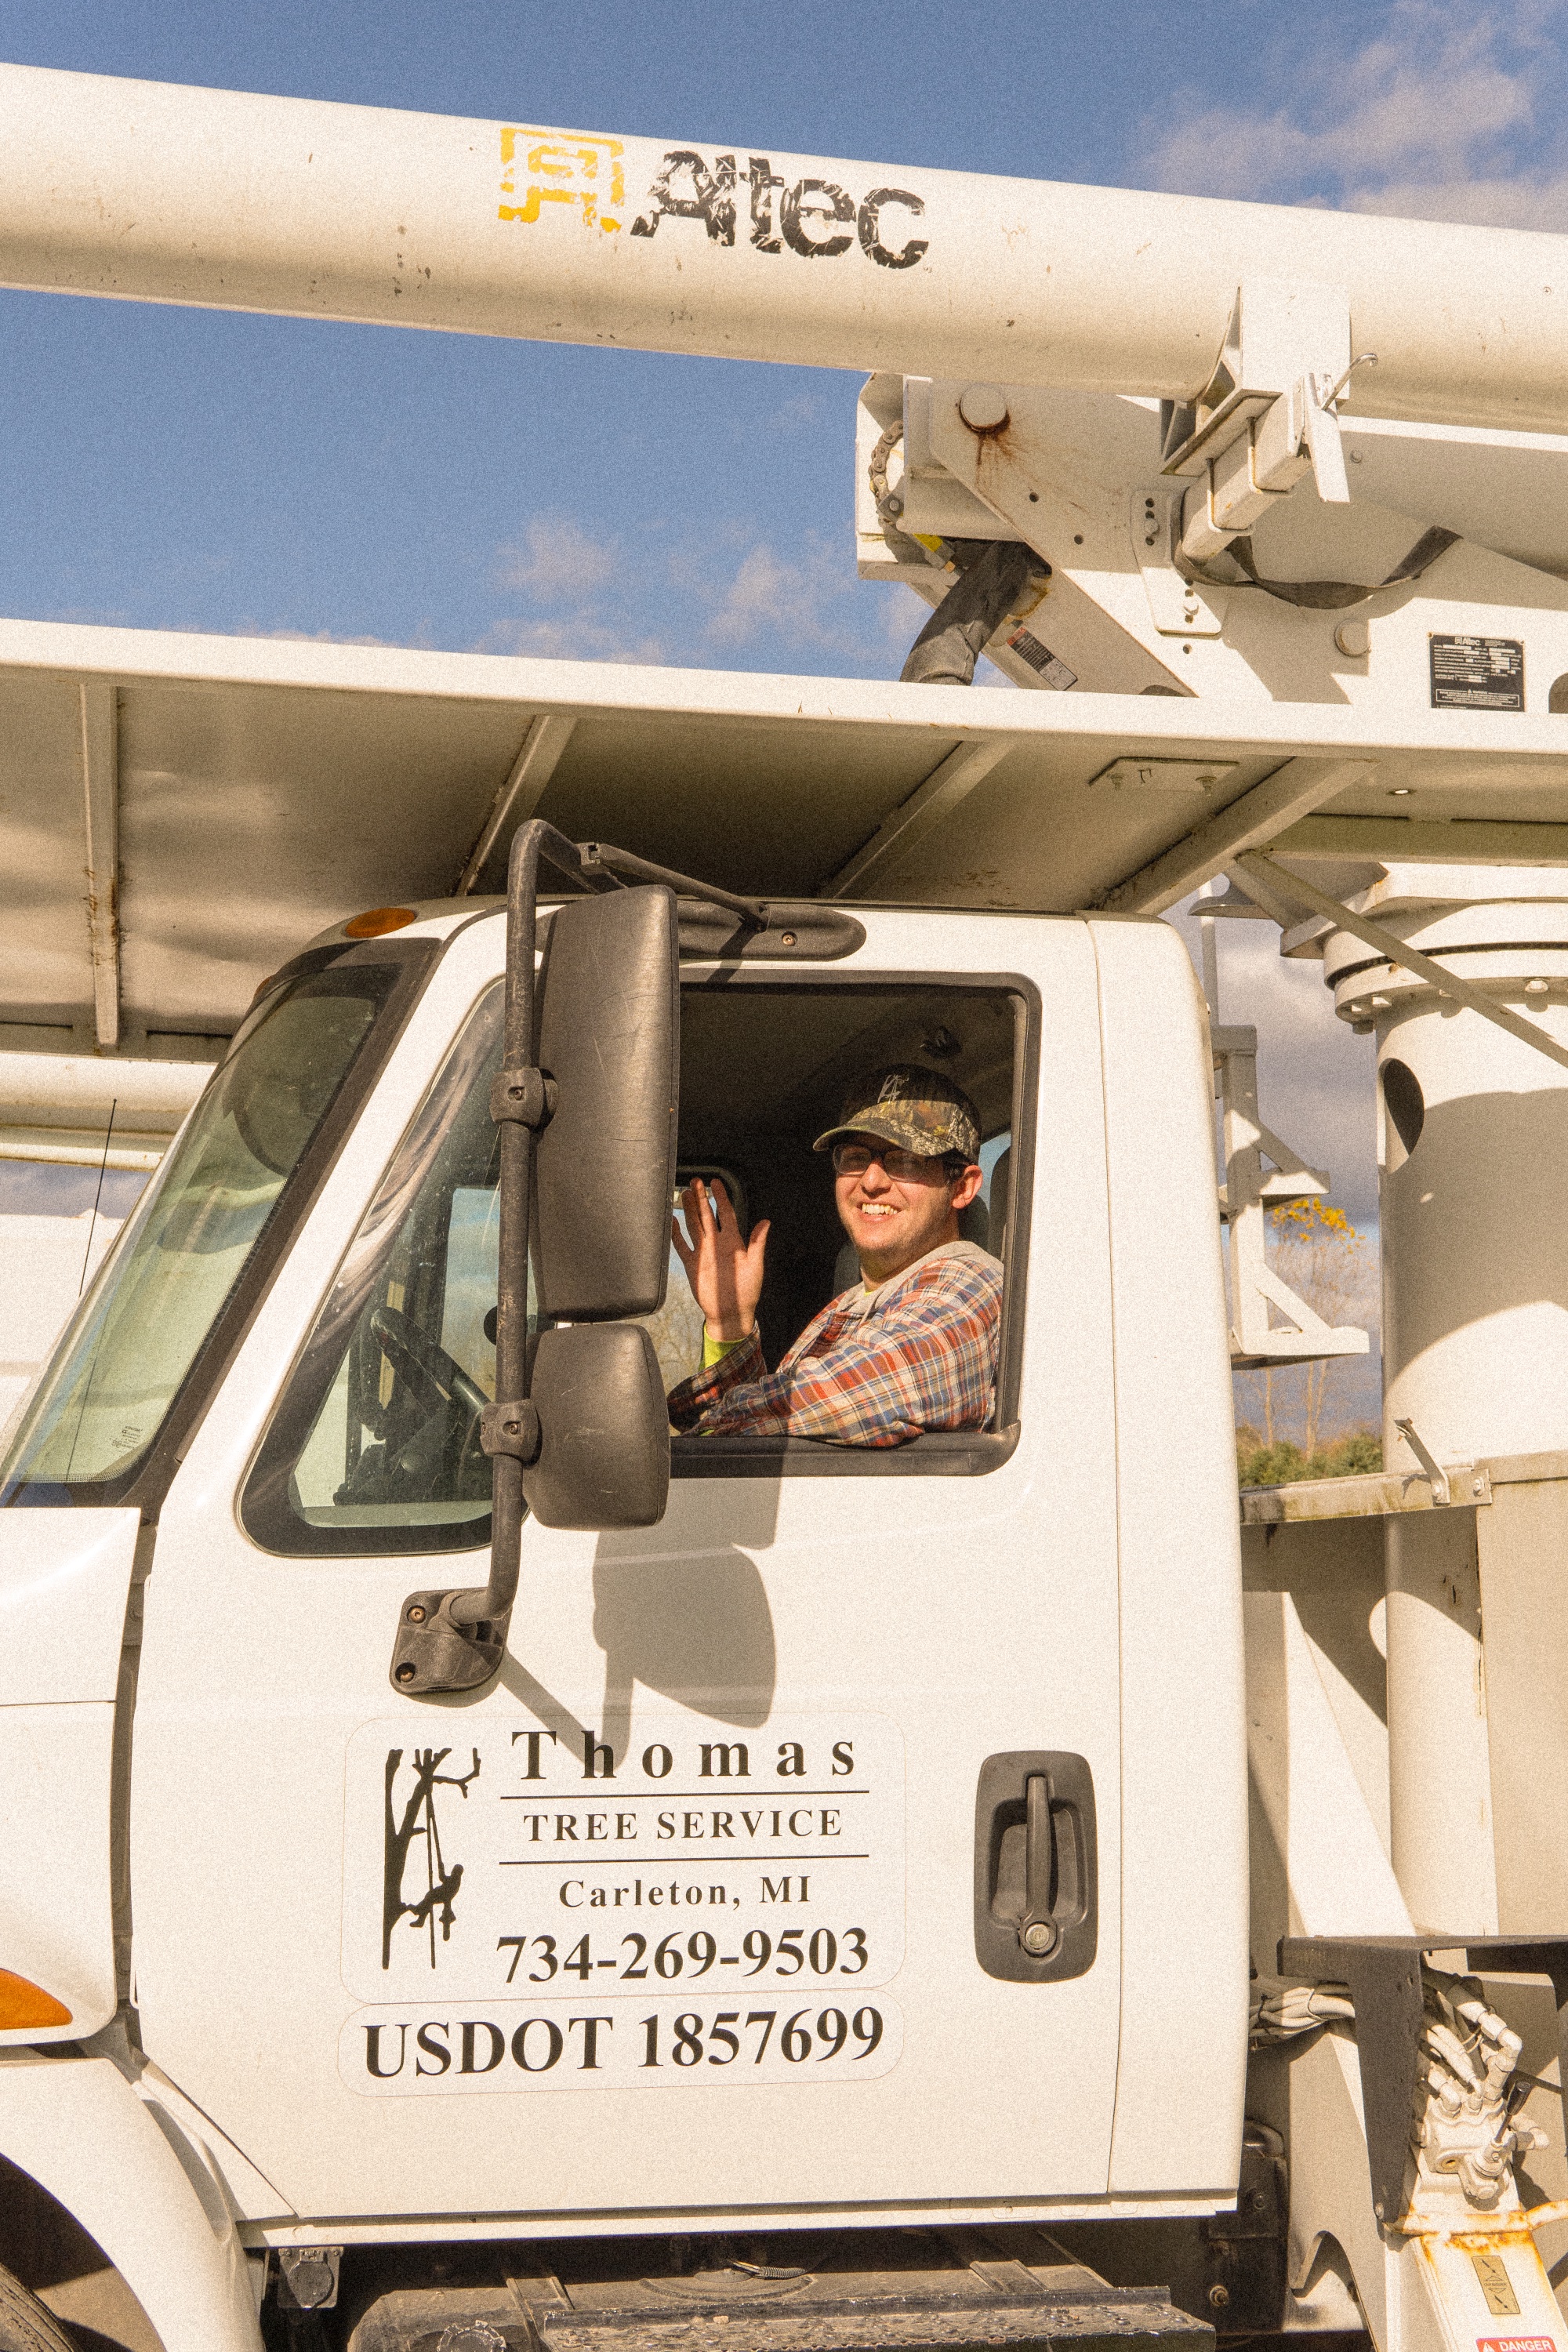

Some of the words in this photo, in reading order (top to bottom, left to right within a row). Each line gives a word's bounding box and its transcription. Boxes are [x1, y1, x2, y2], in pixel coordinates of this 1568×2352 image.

[630, 150, 929, 270] Altec
[511, 1730, 855, 1780] Thomas
[523, 1813, 639, 1842] TREE
[656, 1809, 843, 1840] SERVICE
[559, 1878, 741, 1911] Carleton,
[760, 1875, 811, 1904] MI
[495, 1927, 869, 1984] 734-269-9503
[361, 2016, 613, 2078] USDOT
[637, 2005, 884, 2067] 1857699
[1498, 2339, 1552, 2352] DANGER
